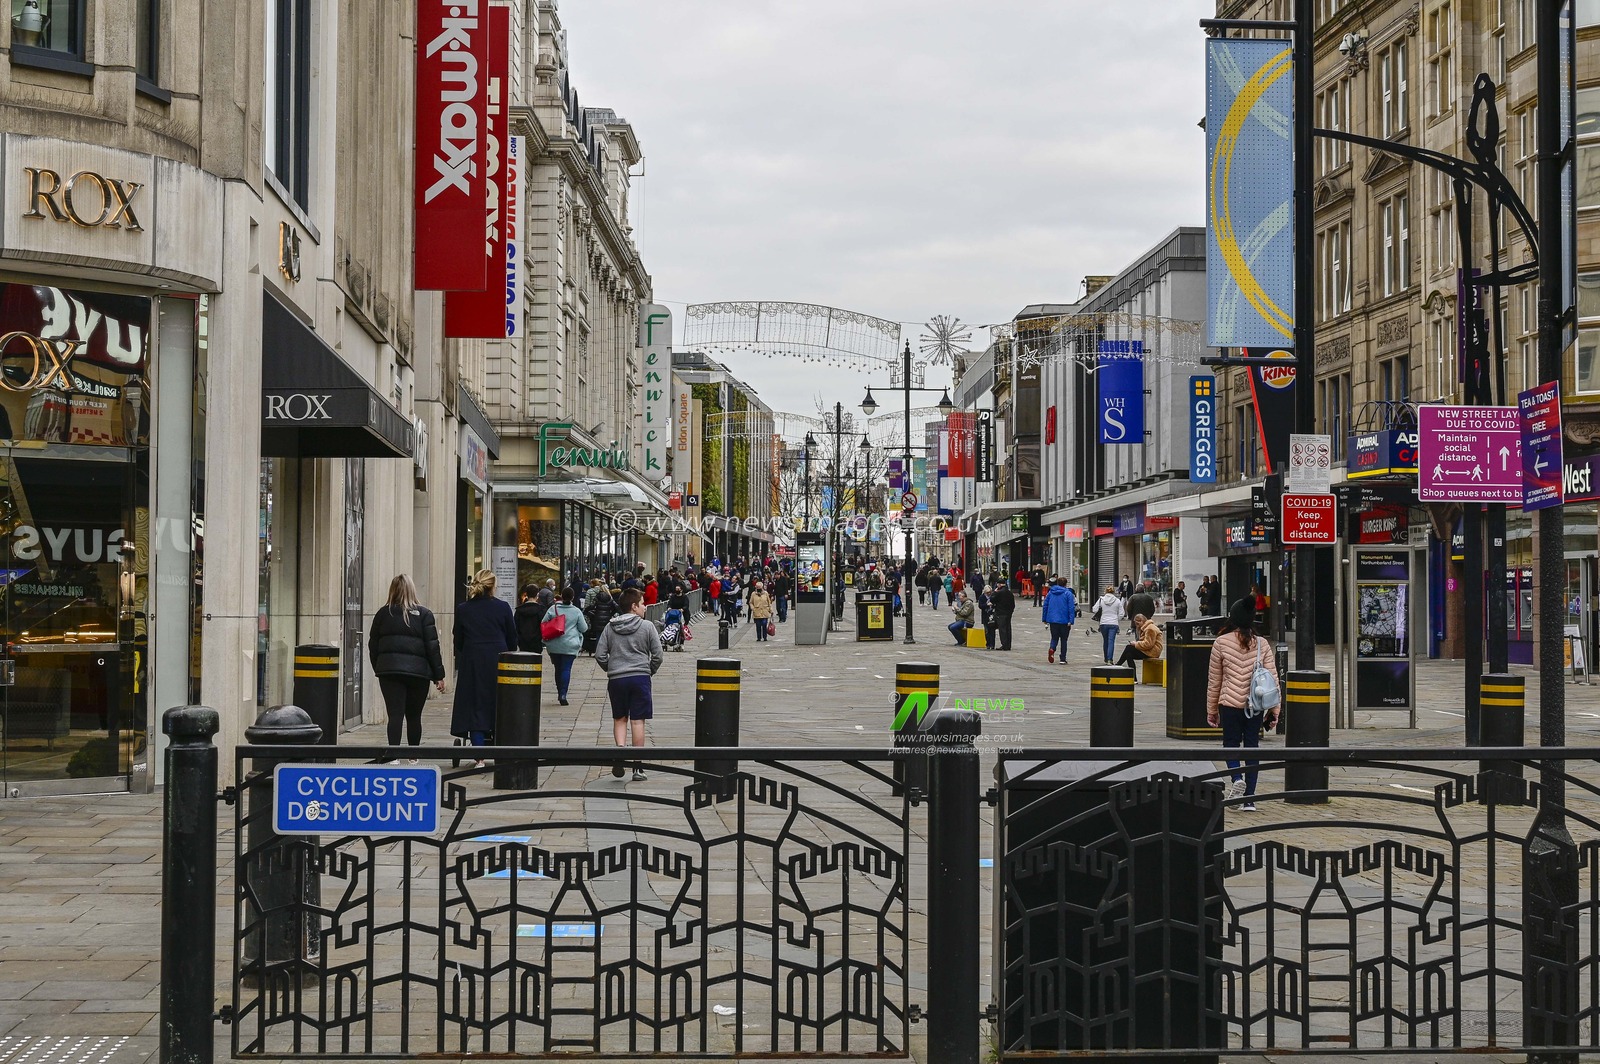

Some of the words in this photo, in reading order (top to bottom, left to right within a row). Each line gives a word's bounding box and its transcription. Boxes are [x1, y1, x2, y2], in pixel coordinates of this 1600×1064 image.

[23, 167, 144, 232] ROX
[1264, 367, 1296, 381] KING
[644, 314, 669, 471] Fenwick
[1521, 398, 1531, 409] TEA
[1536, 390, 1555, 404] TOAST
[265, 394, 332, 420] ROX
[679, 394, 689, 424] Square
[1104, 398, 1125, 407] WH
[978, 411, 989, 420] JD
[1438, 410, 1459, 418] NEW
[1462, 410, 1498, 418] STREET
[1104, 408, 1126, 441] S
[1446, 420, 1466, 428] DUE
[1469, 420, 1482, 428] TO
[1532, 421, 1546, 433] FREE
[678, 426, 687, 451] Eldon
[1195, 400, 1211, 478] GREGGS
[1357, 434, 1379, 450] ADMIRAL
[1438, 434, 1477, 442] Maintain
[1444, 444, 1470, 452] social
[1358, 452, 1378, 466] CASINO
[1438, 453, 1477, 461] distance
[1563, 462, 1591, 494] West
[1422, 488, 1444, 497] Shop
[1286, 498, 1331, 506] COVID-19
[1297, 511, 1320, 520] Keep
[1299, 522, 1319, 530] your
[1363, 519, 1382, 533] BURGER
[1231, 526, 1245, 542] GREG
[1290, 530, 1329, 538] distance
[297, 776, 417, 797] CYCLISTS
[288, 802, 428, 821] DSMOUNT
